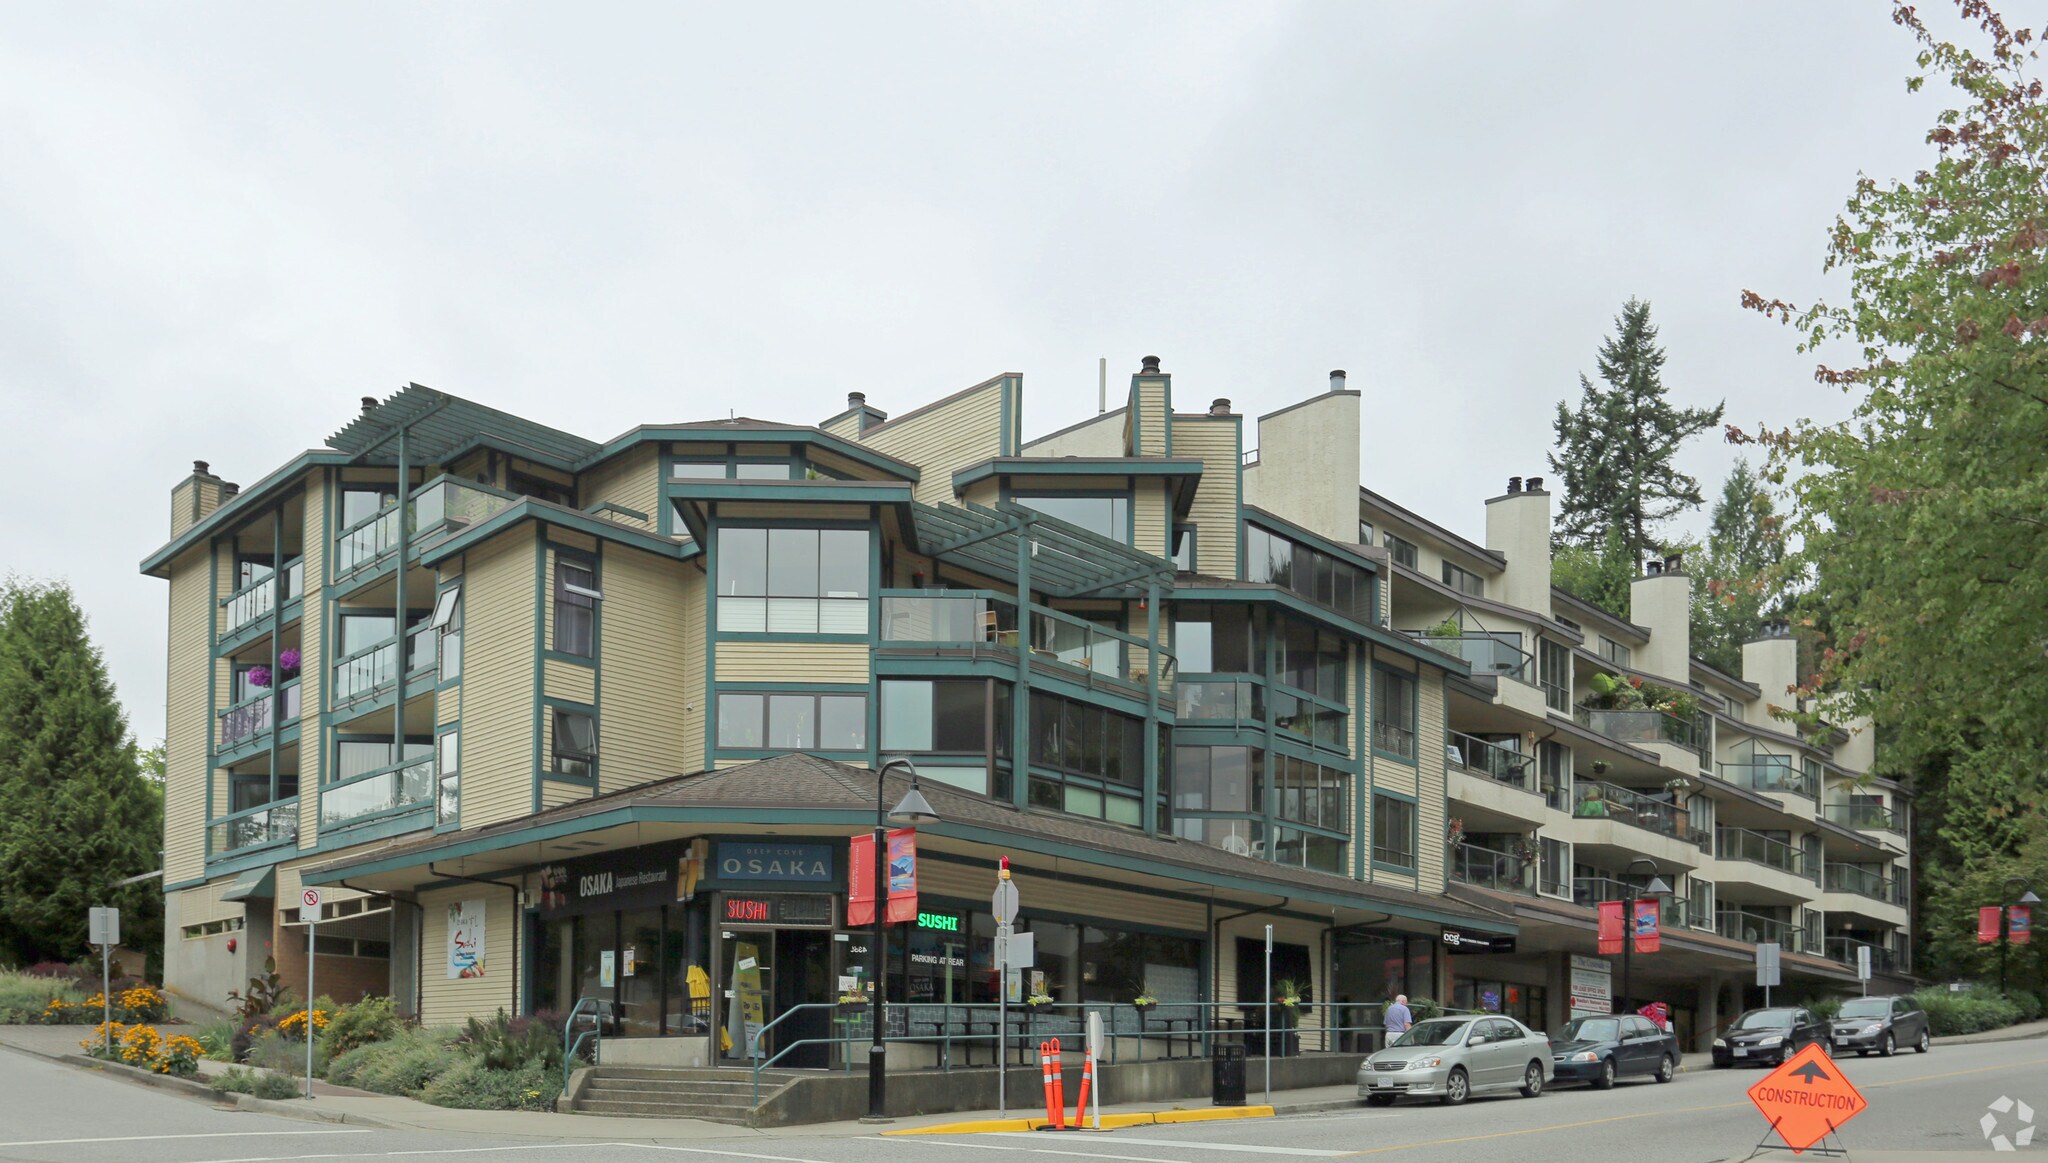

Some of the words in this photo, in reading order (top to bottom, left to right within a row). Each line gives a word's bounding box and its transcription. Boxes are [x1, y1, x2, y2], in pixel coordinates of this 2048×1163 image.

[723, 858, 827, 876] OSAKA
[580, 871, 613, 897] OSAKA
[615, 875, 638, 889] Japanese
[639, 868, 667, 885] Restaurant
[727, 899, 768, 920] SUSHI
[918, 912, 958, 931] SUSHI
[1443, 933, 1460, 945] ccg
[911, 954, 937, 964] PARKING
[939, 957, 946, 965] AT
[948, 957, 964, 966] REAR
[1757, 1086, 1856, 1111] CONSTRUCTION
